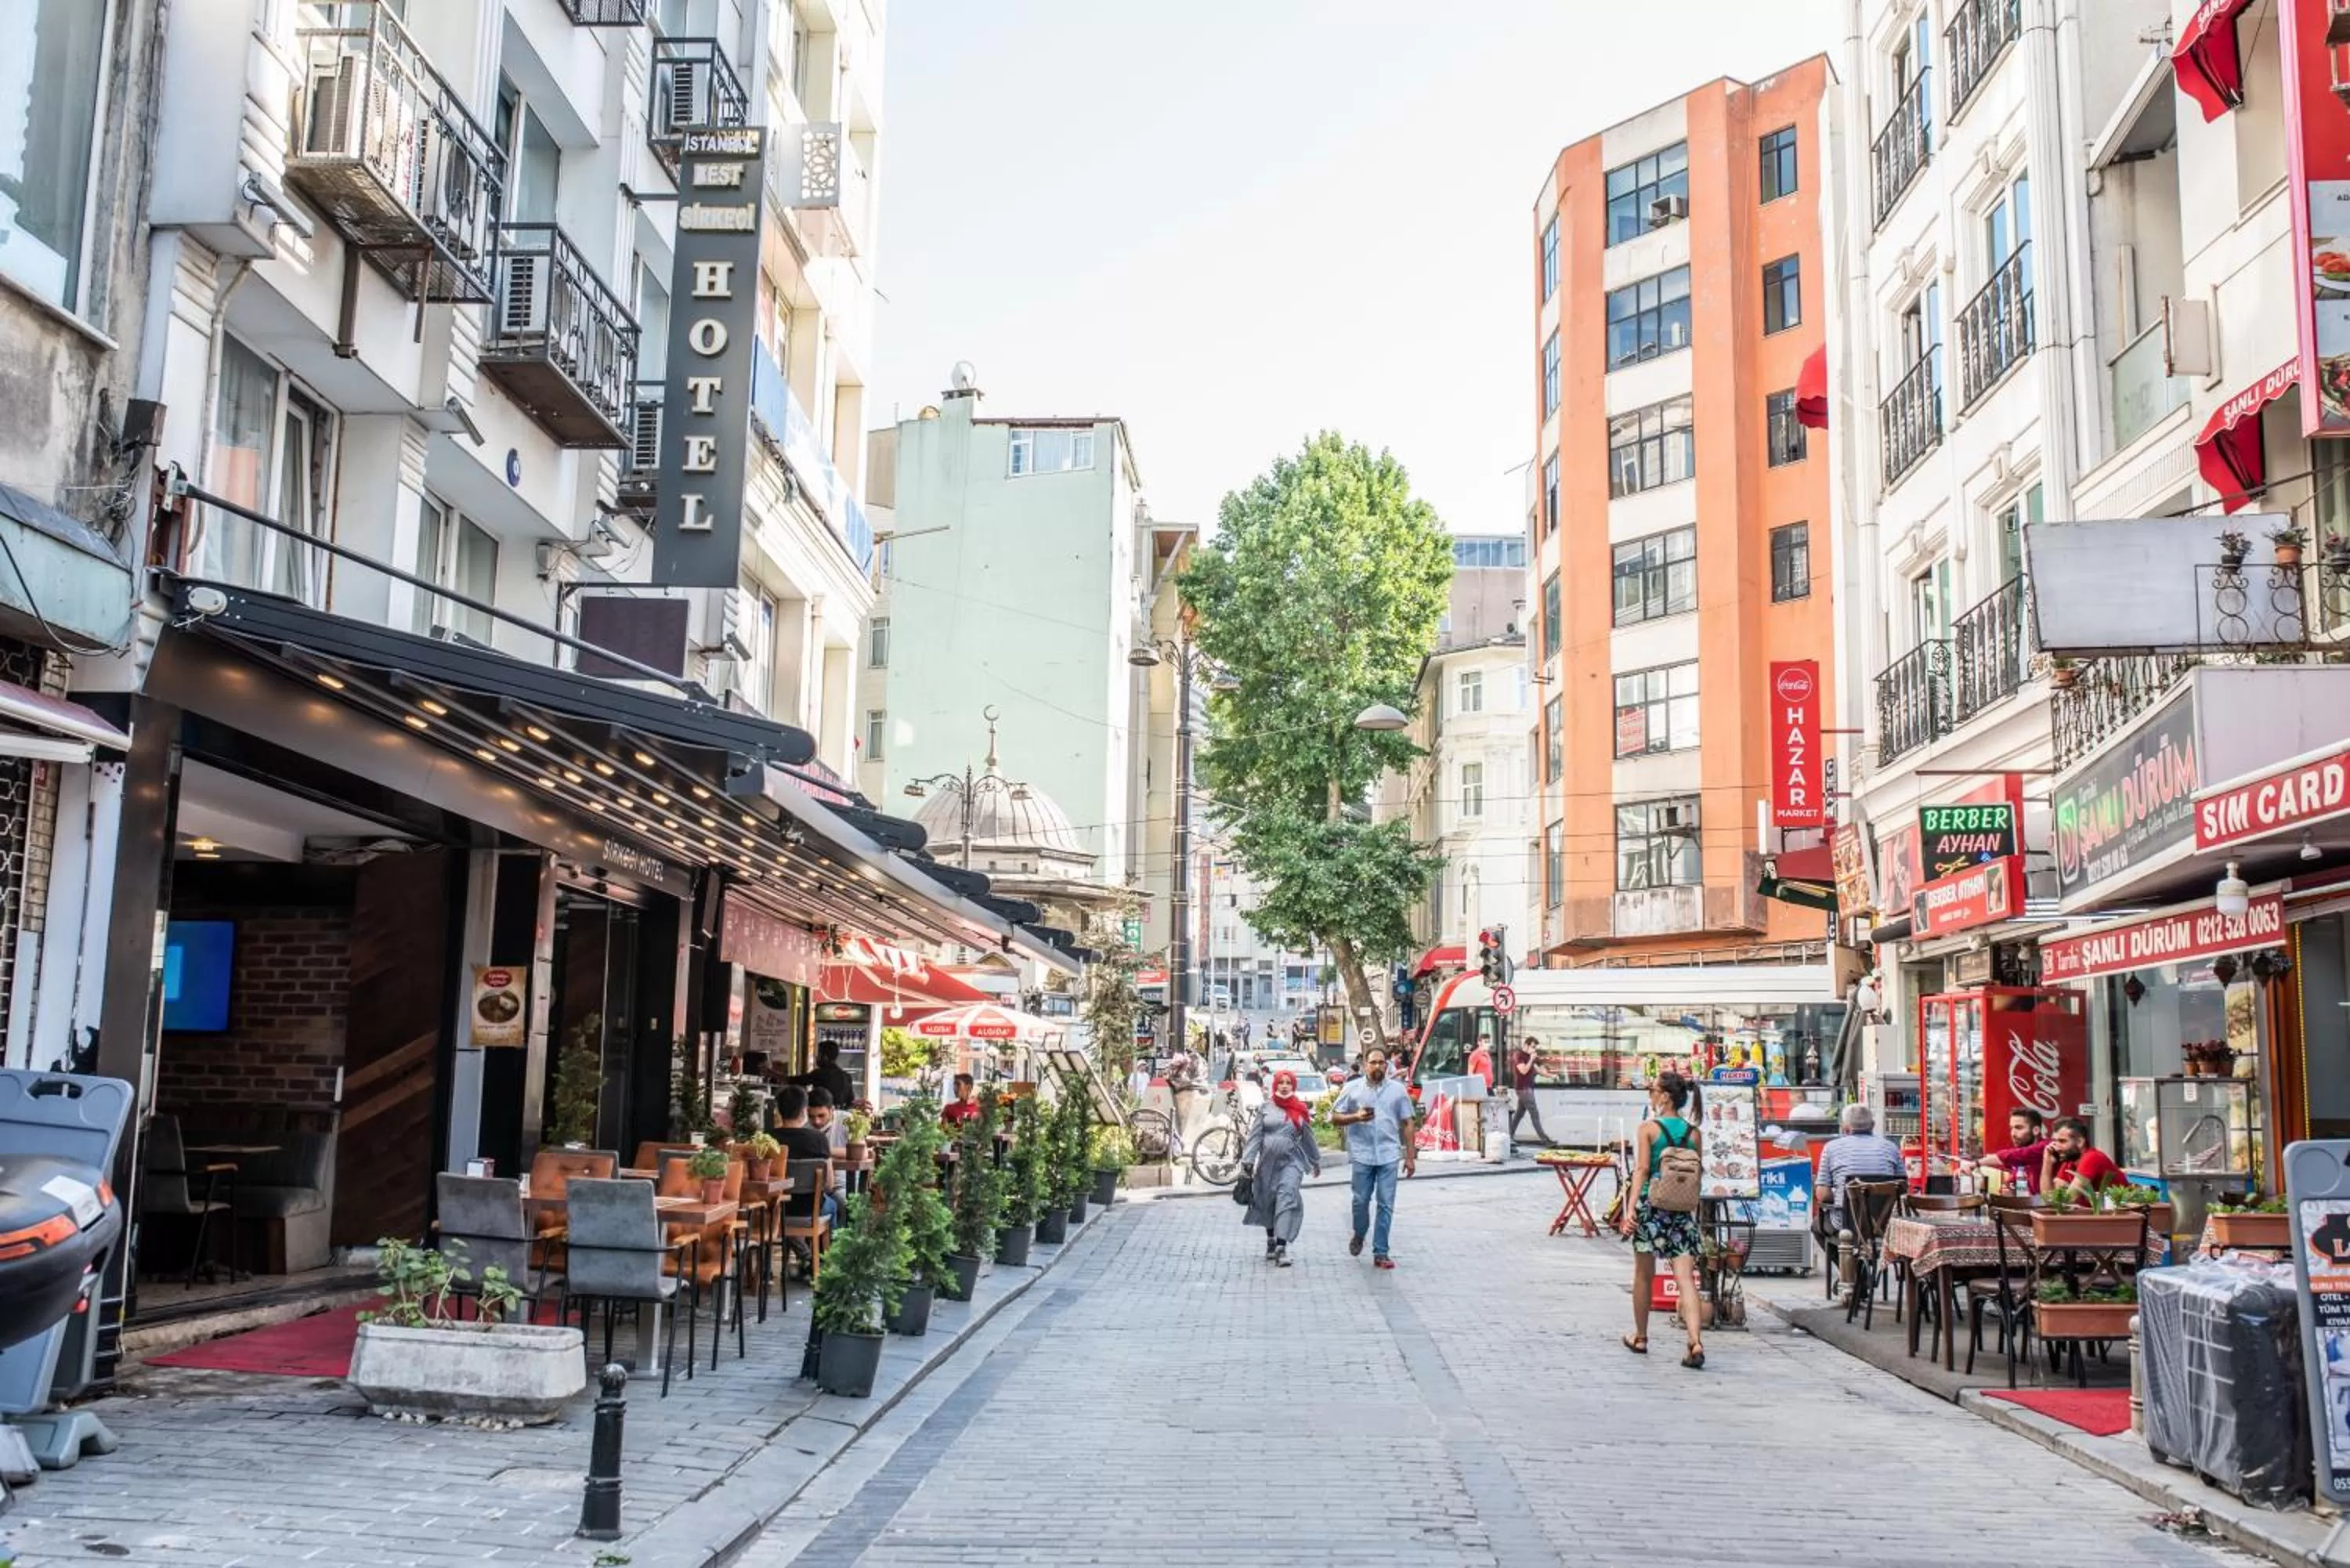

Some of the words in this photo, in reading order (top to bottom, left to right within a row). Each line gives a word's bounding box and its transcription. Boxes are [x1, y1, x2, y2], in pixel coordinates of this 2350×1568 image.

[678, 261, 735, 532] HOTEL
[1786, 706, 1806, 806] HAZAR
[2121, 733, 2197, 829] DÜRÜM
[1777, 808, 1819, 818] MARKET
[1925, 807, 2008, 830] BERBER
[2202, 792, 2250, 840] SIM
[2257, 763, 2345, 824] CARD
[1936, 833, 2002, 853] AYHAN
[2081, 933, 2125, 973] ŞANLI
[2130, 916, 2191, 959] DÜRÜM
[2196, 914, 2222, 946] 0212
[2224, 913, 2245, 941] 528
[2248, 901, 2280, 936] 0063
[1760, 1171, 1786, 1184] rikli
